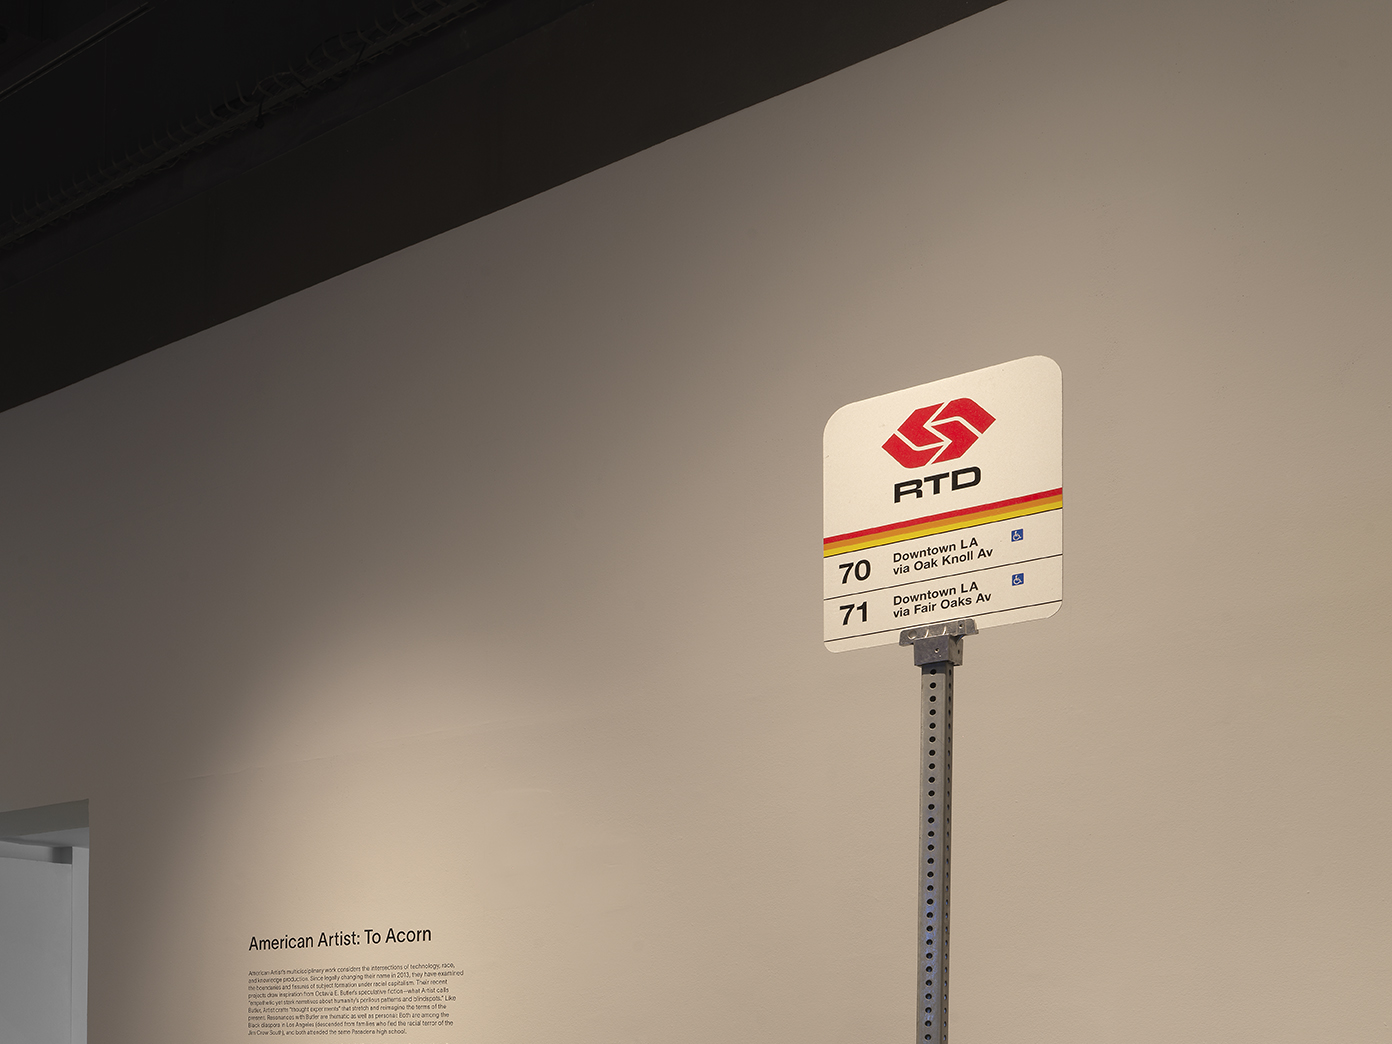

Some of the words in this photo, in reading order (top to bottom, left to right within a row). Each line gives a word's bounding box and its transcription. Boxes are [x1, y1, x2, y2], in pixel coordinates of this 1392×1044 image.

[894, 466, 981, 503] RTD
[893, 543, 956, 562] Downtown
[961, 537, 978, 548] LA
[893, 565, 910, 575] via
[914, 558, 938, 570] Oak
[942, 551, 973, 565] Knoll
[978, 548, 993, 558] Av
[839, 560, 871, 584] 70
[893, 587, 956, 605] Downtown
[961, 581, 978, 592] LA
[893, 608, 910, 618] via
[914, 603, 937, 614] Fair
[941, 597, 972, 609] Oaks
[976, 593, 991, 603] Av
[839, 601, 868, 626] 71
[249, 935, 313, 950] American
[318, 931, 360, 947] Artist:
[364, 929, 381, 944] To
[385, 928, 431, 943] Acorn
